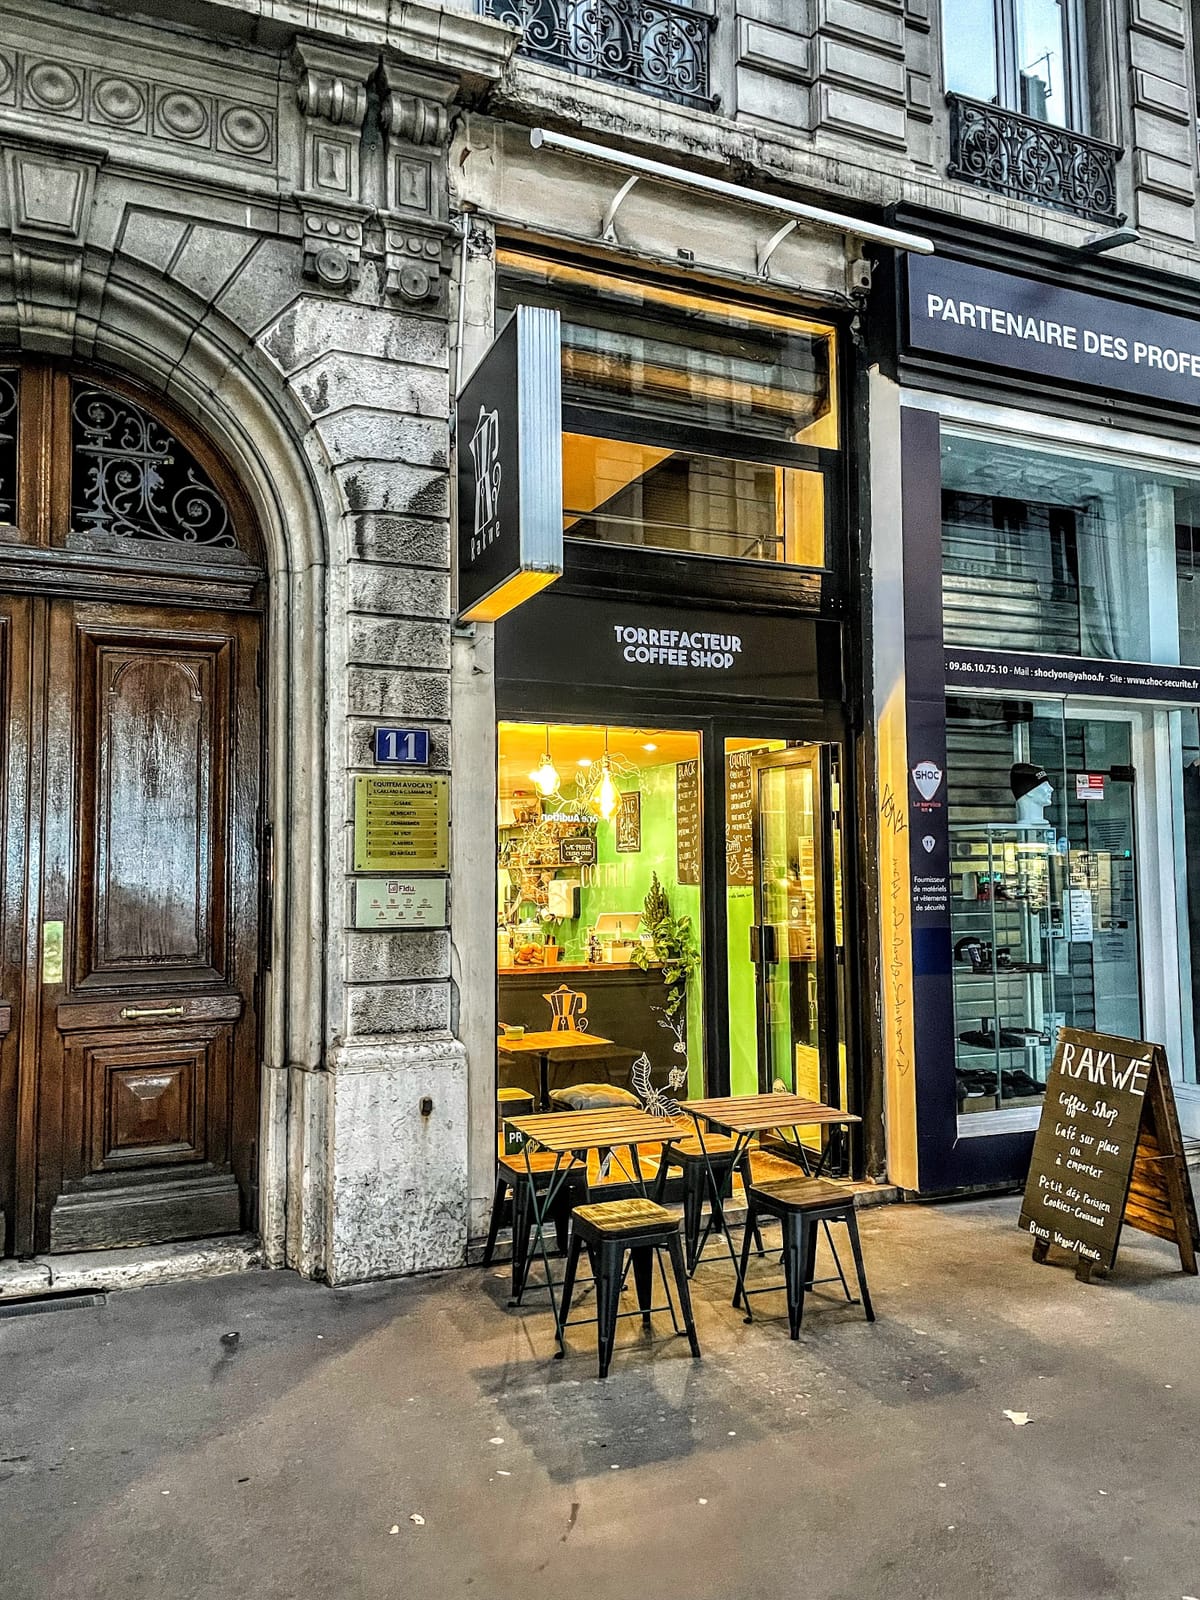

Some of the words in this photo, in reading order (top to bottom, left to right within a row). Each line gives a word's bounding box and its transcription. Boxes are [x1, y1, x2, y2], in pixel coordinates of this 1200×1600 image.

[927, 294, 1077, 350] PARTENAIRE
[1083, 330, 1128, 361] DES
[614, 625, 742, 652] TORREFACTEUR
[623, 645, 688, 667] COFFEE
[690, 650, 734, 669] SHOP
[949, 662, 1008, 674] 09.86.10.75.10
[1034, 669, 1105, 682] shoclyon@yahoo.fr
[1110, 673, 1122, 684] Site
[1127, 676, 1199, 690] www.shoc-securite.fr
[385, 732, 417, 760] 11
[915, 770, 940, 780] SHOC
[913, 875, 946, 883] Fournisseur
[913, 884, 921, 893] de
[922, 884, 947, 893] matériels
[915, 904, 923, 912] de
[924, 903, 946, 912] sécurité
[920, 894, 947, 902] vêtements
[1060, 1043, 1152, 1096] RAKWÉ
[1059, 1091, 1088, 1118] Coffee
[1092, 1100, 1119, 1127] Shop
[1055, 1122, 1077, 1141] Café
[1079, 1131, 1096, 1145] sur
[1097, 1138, 1120, 1157] place
[1070, 1146, 1081, 1157] ou
[1055, 1153, 1062, 1166] à
[1066, 1159, 1104, 1179] emporter
[1038, 1174, 1064, 1196] Petit
[1083, 1191, 1111, 1214] Parisien
[1029, 1220, 1050, 1239] Buns
[1054, 1232, 1102, 1262] Veggie/Viande
